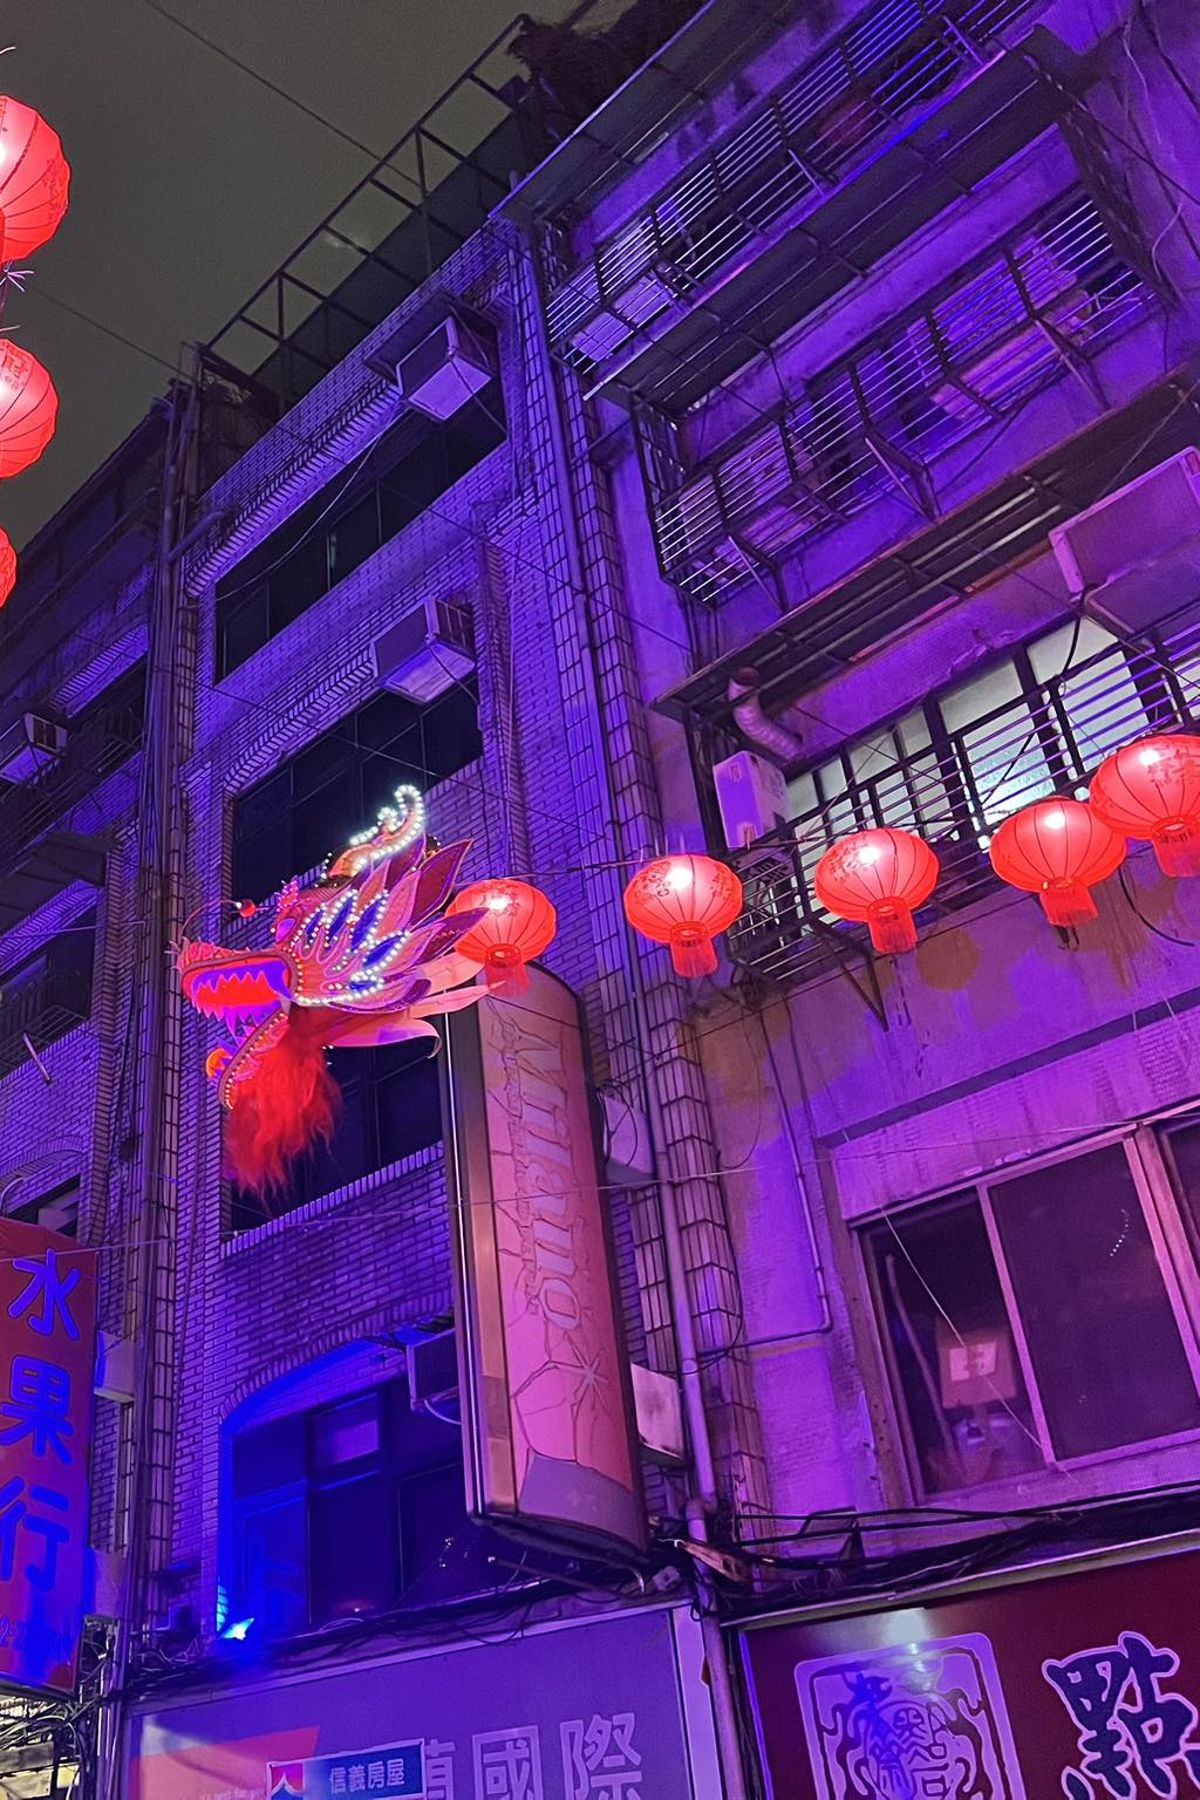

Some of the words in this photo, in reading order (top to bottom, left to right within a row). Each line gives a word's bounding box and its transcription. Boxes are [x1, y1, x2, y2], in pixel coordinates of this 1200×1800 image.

[511, 1026, 581, 1332] Milano
[329, 1758, 406, 1796] 信義房屋
[1042, 1631, 1200, 1800] 點
